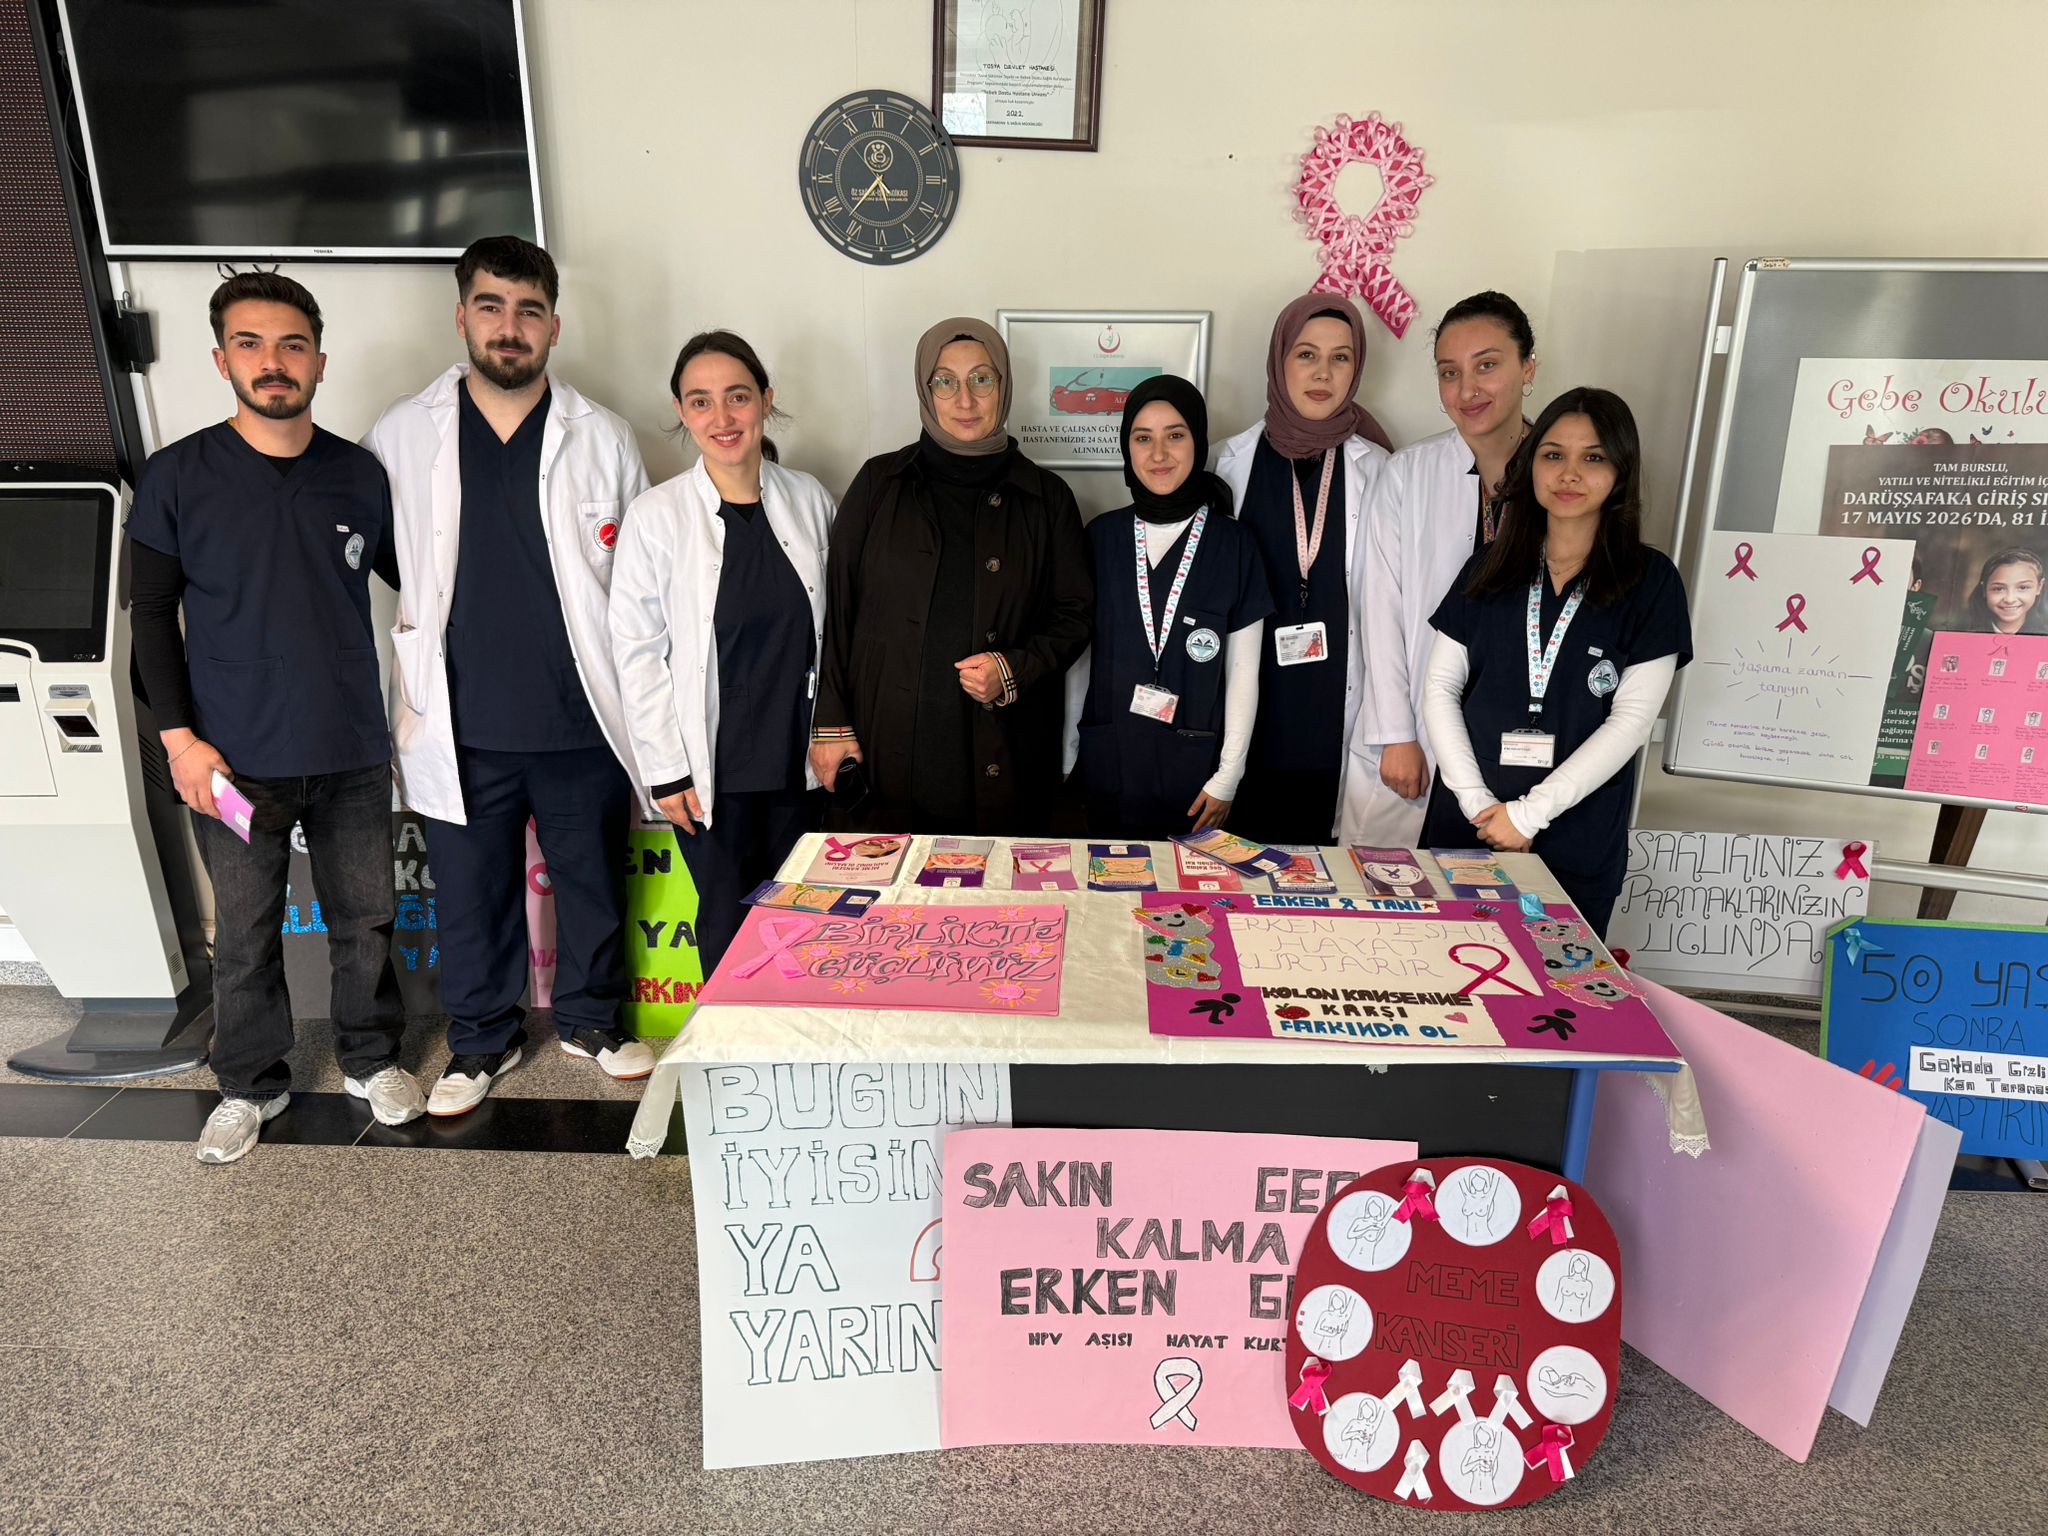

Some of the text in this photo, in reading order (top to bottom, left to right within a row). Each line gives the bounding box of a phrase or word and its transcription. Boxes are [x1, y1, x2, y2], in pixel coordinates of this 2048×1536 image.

[871, 111, 884, 129] XII
[1827, 375, 1922, 419] Gebe
[1021, 425, 1047, 433] HASTA
[1049, 425, 1060, 433] VE
[1062, 425, 1096, 435] ÇALIŞAN
[1023, 435, 1118, 444] HASTANEMİZDE 24 SAAT
[1933, 463, 2009, 474] TAM BURSLU,
[1878, 476, 1914, 486] YATILI
[1916, 476, 1930, 486] VE
[1932, 475, 1992, 486] NİTELİKLİ
[1993, 475, 2035, 487] EĞİTİM
[1843, 491, 1973, 509] DARÜŞŞAFAKA
[1976, 489, 2028, 509] GİRİŞ
[1841, 511, 1862, 526] 17
[1867, 511, 1922, 526] MAYIS
[2011, 511, 2036, 527] 81
[1732, 661, 1848, 680] yaşama zaman
[1758, 681, 1809, 698] tanıyın
[1256, 895, 1421, 912] ERKEN TANI
[1621, 874, 1864, 921] PARMAKLARINIZIN
[796, 915, 1063, 949] BİRLİKTE
[1228, 917, 1336, 934] ERKEN
[1270, 935, 1423, 956] HAYAT
[1861, 953, 1943, 1004] 50
[626, 976, 705, 1004] RKIN
[1262, 986, 1473, 1007] KOLON KANSERİNE
[1321, 1003, 1408, 1022] KARŞI
[1280, 1019, 1458, 1039] FARKINDA OL
[1911, 1011, 2026, 1052] SONRA
[1919, 1052, 2046, 1078] Gaitada Gizli
[1943, 1077, 1975, 1092] Kan
[962, 1160, 1113, 1208] SAKIN
[1096, 1217, 1290, 1266] KALMA
[724, 1223, 840, 1297] YA
[1000, 1267, 1178, 1317] ERKEN
[1407, 1260, 1520, 1307] MEME
[1028, 1331, 1288, 1352] HPV AŞISI HAYAT KUR
[1375, 1312, 1520, 1369] KANSERİ
